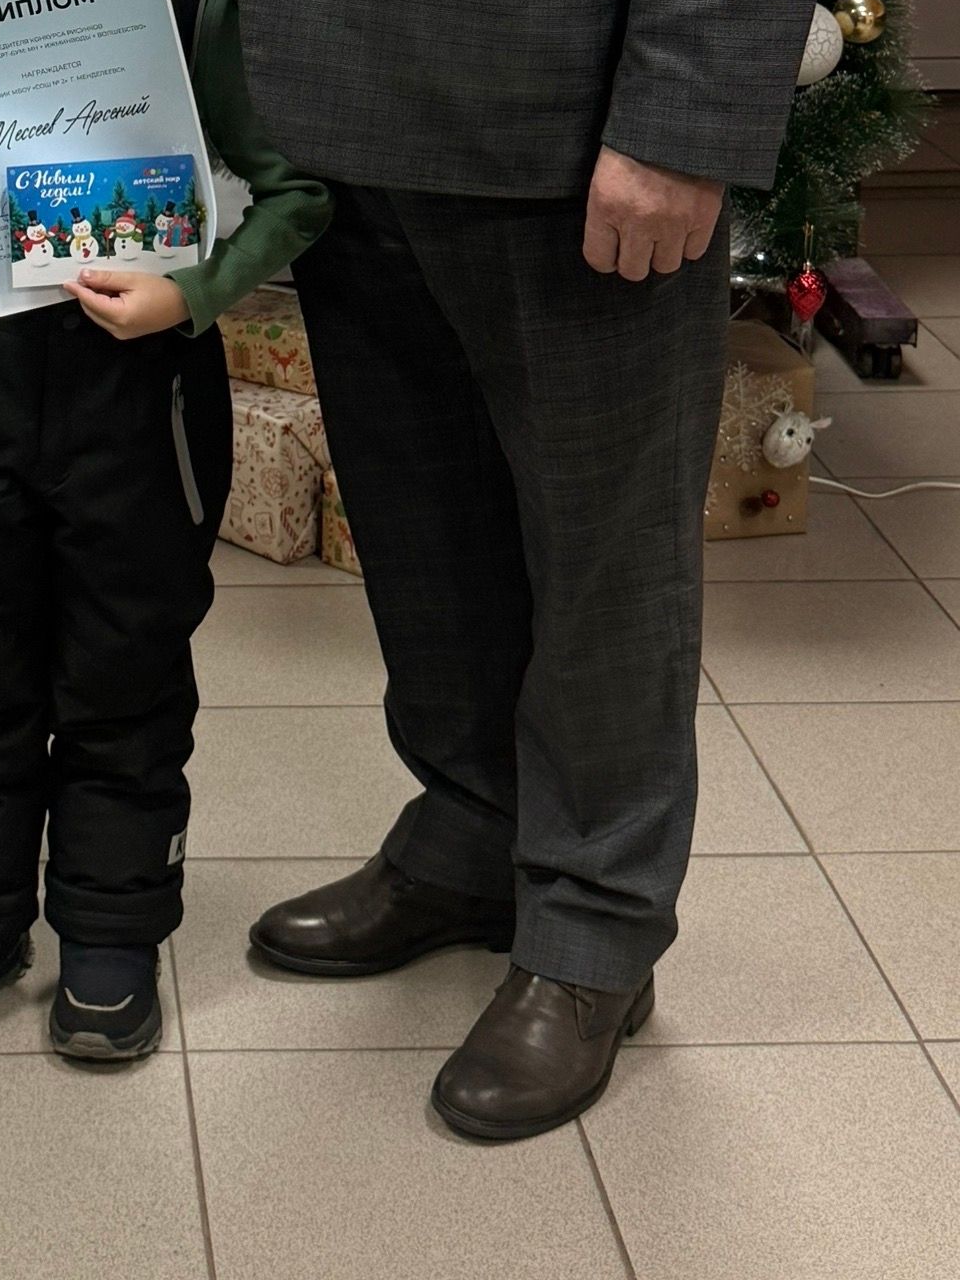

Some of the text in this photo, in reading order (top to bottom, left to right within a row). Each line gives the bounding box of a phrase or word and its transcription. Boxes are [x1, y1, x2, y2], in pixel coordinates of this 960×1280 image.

[21, 60, 82, 79] НАГРАЖДАЕТСЯ
[63, 95, 151, 136] Арсений
[15, 168, 87, 190] С Новым
